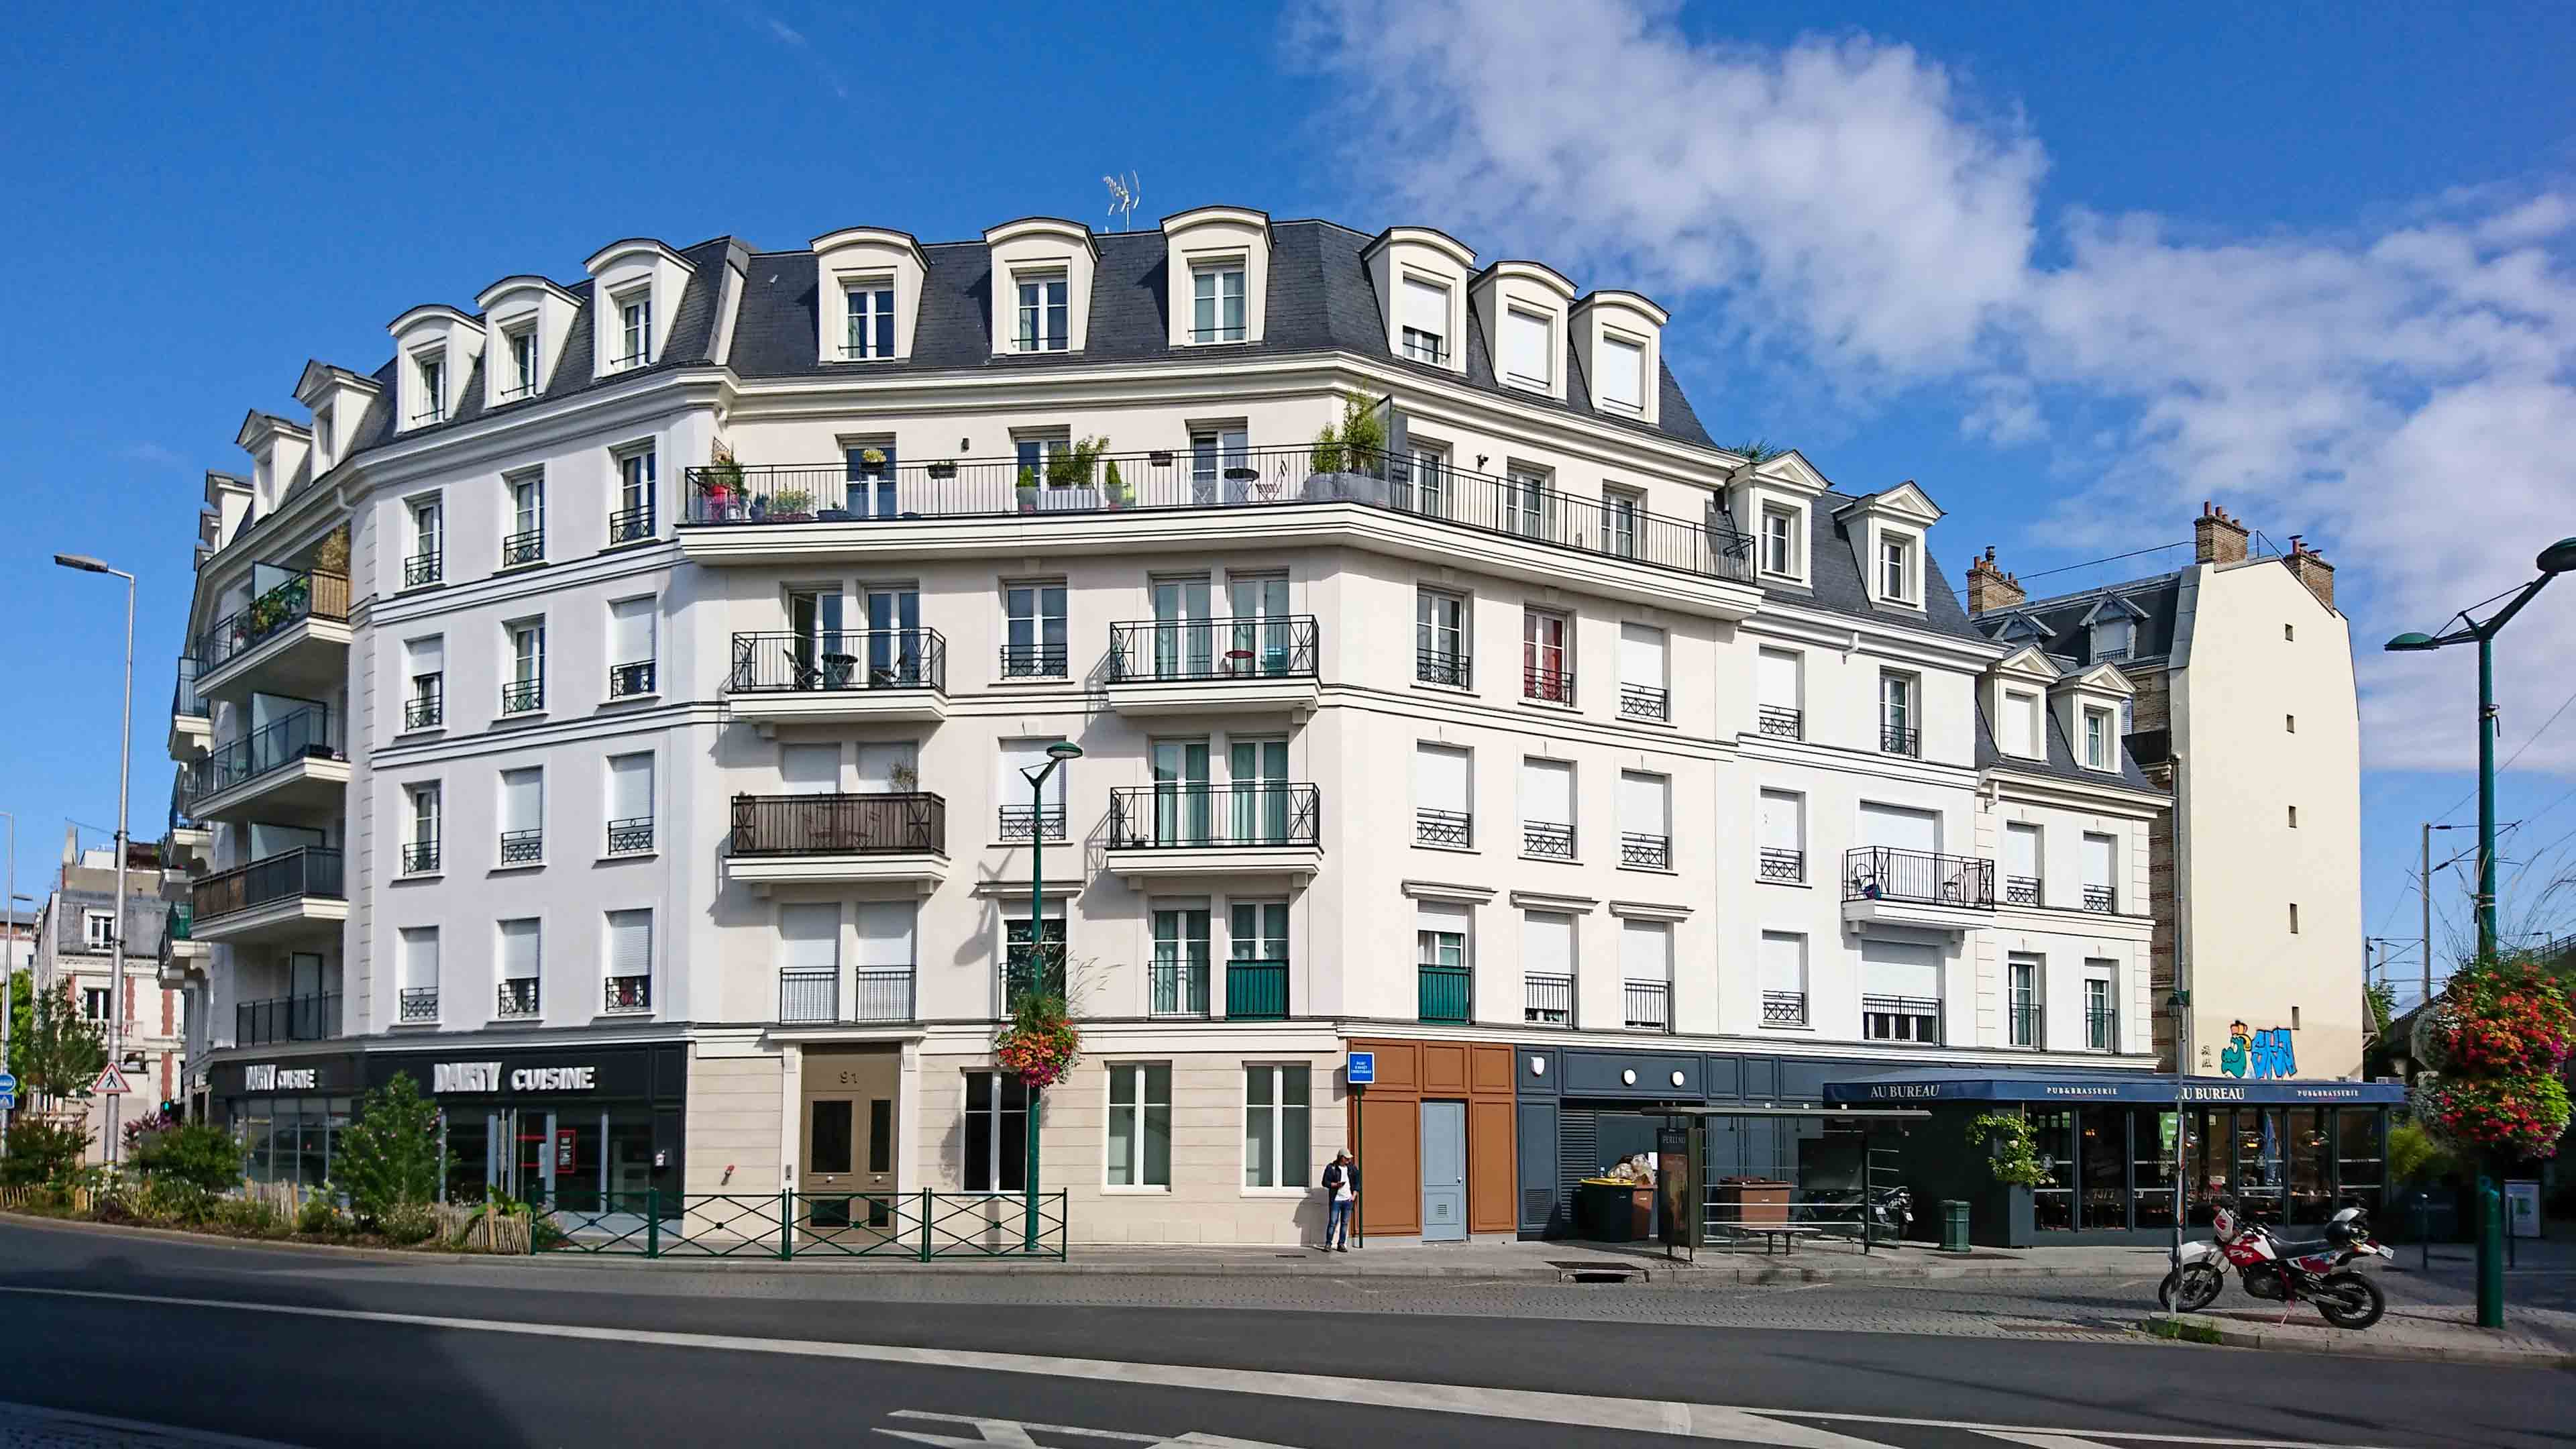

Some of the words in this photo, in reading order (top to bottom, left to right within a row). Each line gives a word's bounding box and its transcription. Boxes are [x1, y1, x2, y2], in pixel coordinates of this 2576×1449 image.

[278, 1069, 315, 1089] CUISINE
[434, 1062, 502, 1093] DARTY
[511, 1067, 595, 1090] CUISINE
[1870, 1086, 1887, 1098] AU
[1889, 1084, 1940, 1097] BUREAU
[2047, 1087, 2118, 1095] PUB&BRASSERIE
[2195, 1087, 2245, 1099] BUREAU
